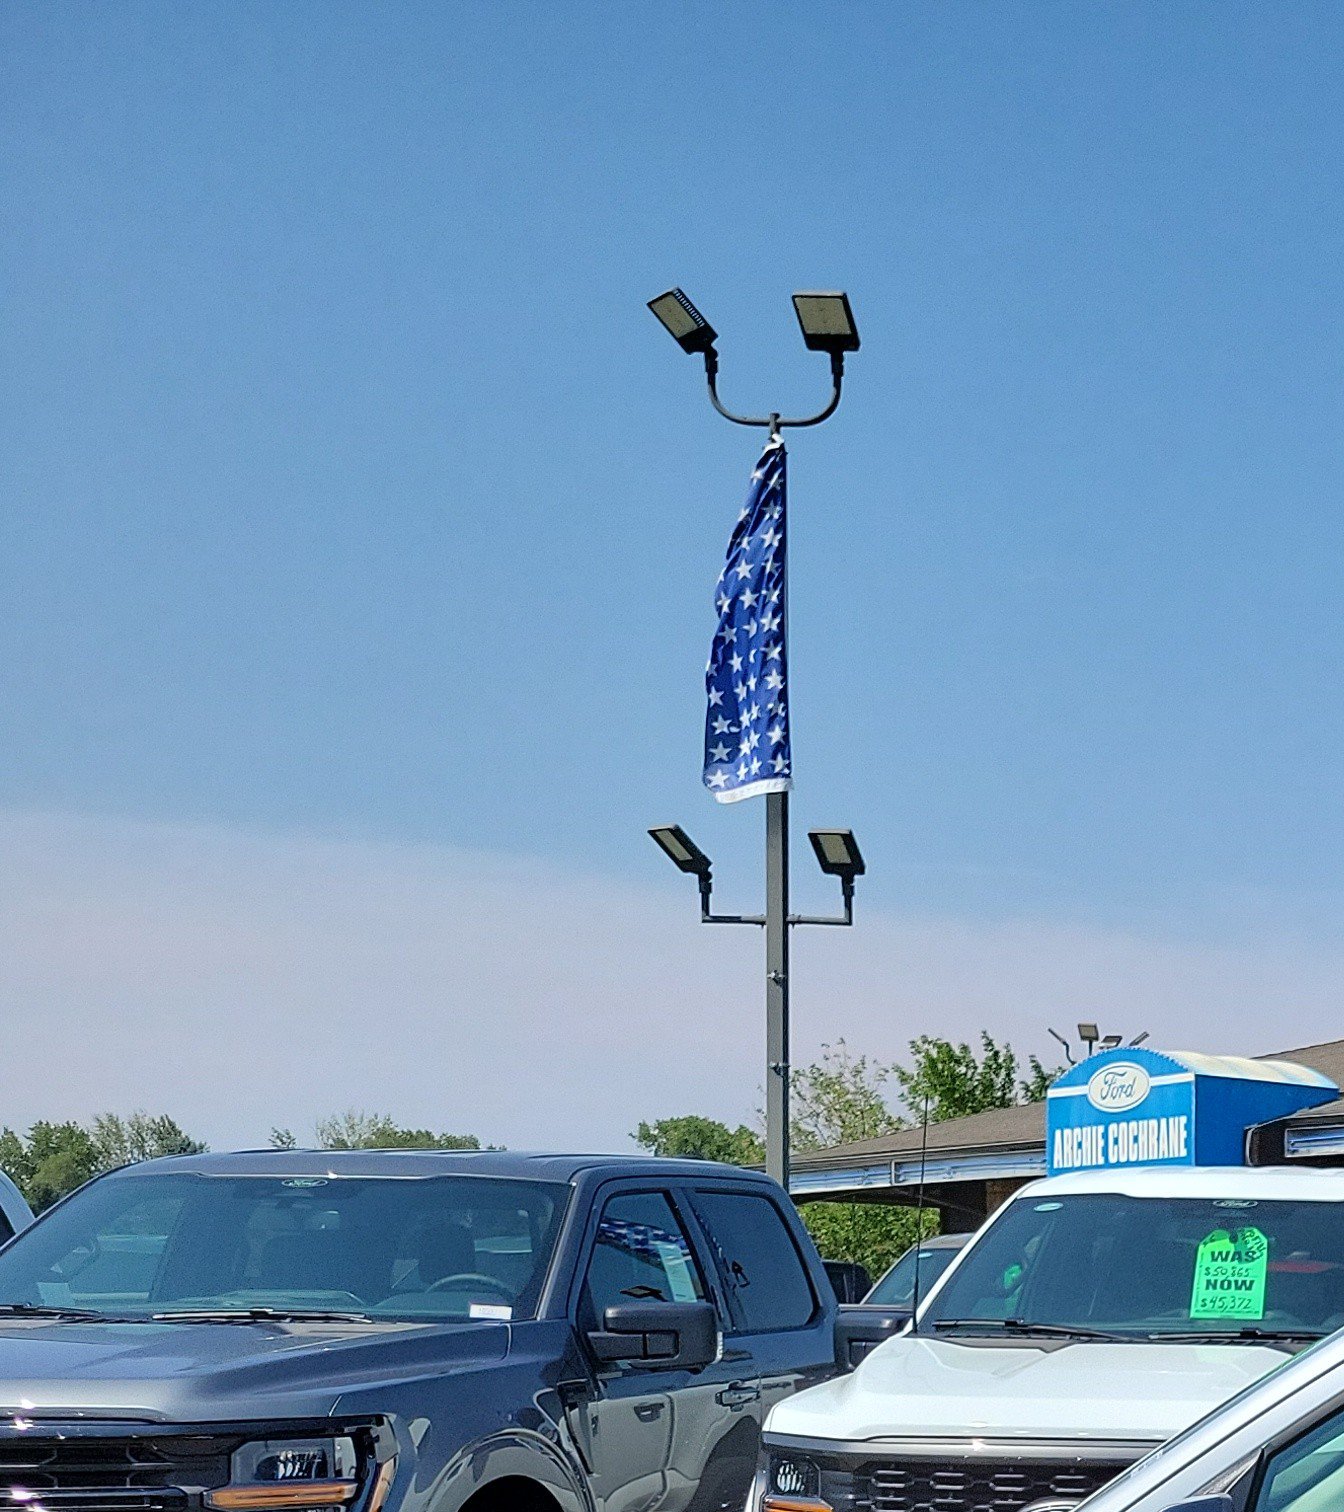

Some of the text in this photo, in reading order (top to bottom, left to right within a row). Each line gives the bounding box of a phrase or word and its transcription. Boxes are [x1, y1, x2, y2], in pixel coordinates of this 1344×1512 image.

[1100, 1071, 1135, 1100] Ford
[1053, 1116, 1187, 1169] ARCHIE COCHRANE
[1211, 1250, 1257, 1263] WAS
[1205, 1279, 1255, 1291] NOW
